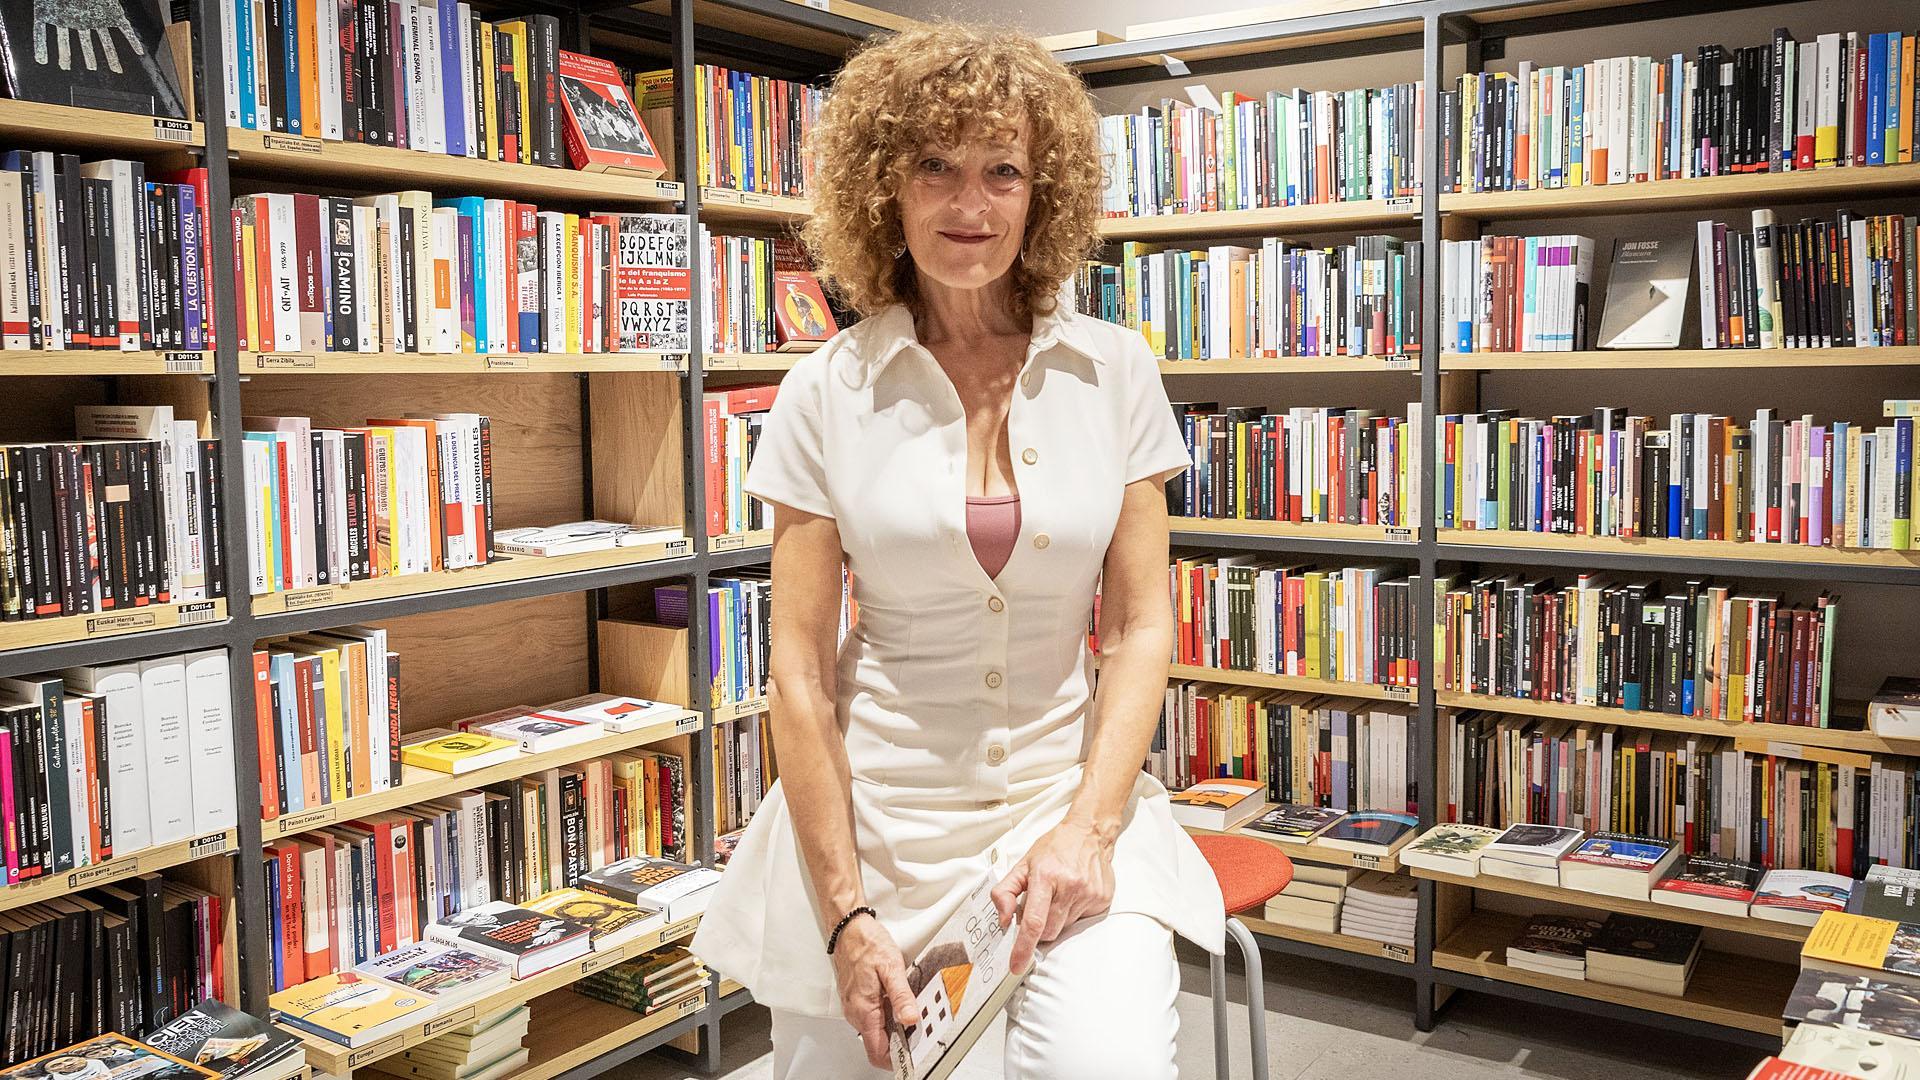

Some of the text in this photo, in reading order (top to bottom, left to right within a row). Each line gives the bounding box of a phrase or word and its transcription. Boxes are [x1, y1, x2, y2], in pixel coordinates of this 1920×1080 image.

[411, 6, 423, 84] EL GERMINAL ESPAÑOL
[1774, 57, 1782, 66] Las
[344, 54, 354, 102] EXTREMADURA
[546, 73, 555, 103] 1923
[1889, 87, 1897, 107] DRAG
[1773, 103, 1781, 123] Patricio
[1572, 124, 1581, 148] Zero
[1622, 241, 1659, 250] JON FOSSE
[184, 212, 198, 310] LA CUESTION FORAL
[307, 275, 315, 307] LosTopos
[338, 257, 351, 315] CAMINO
[472, 427, 481, 503] IMBORRABLES
[483, 461, 491, 478] VOCES
[348, 493, 357, 517] LLAMAS
[350, 527, 359, 556] CÁRCELES
[389, 677, 399, 761] LA BANDA NEGRA
[41, 803, 49, 840] URRALBURU
[202, 833, 223, 844] D011-3
[566, 818, 578, 887] BONAPARTE
[95, 867, 110, 876] gerra
[286, 874, 293, 882] de
[1730, 863, 1759, 872] Molino
[965, 916, 989, 949] del
[1529, 924, 1592, 938] COBALTO
[977, 943, 995, 984] hilo
[432, 1018, 453, 1029] Alemania
[356, 1050, 374, 1059] Europa
